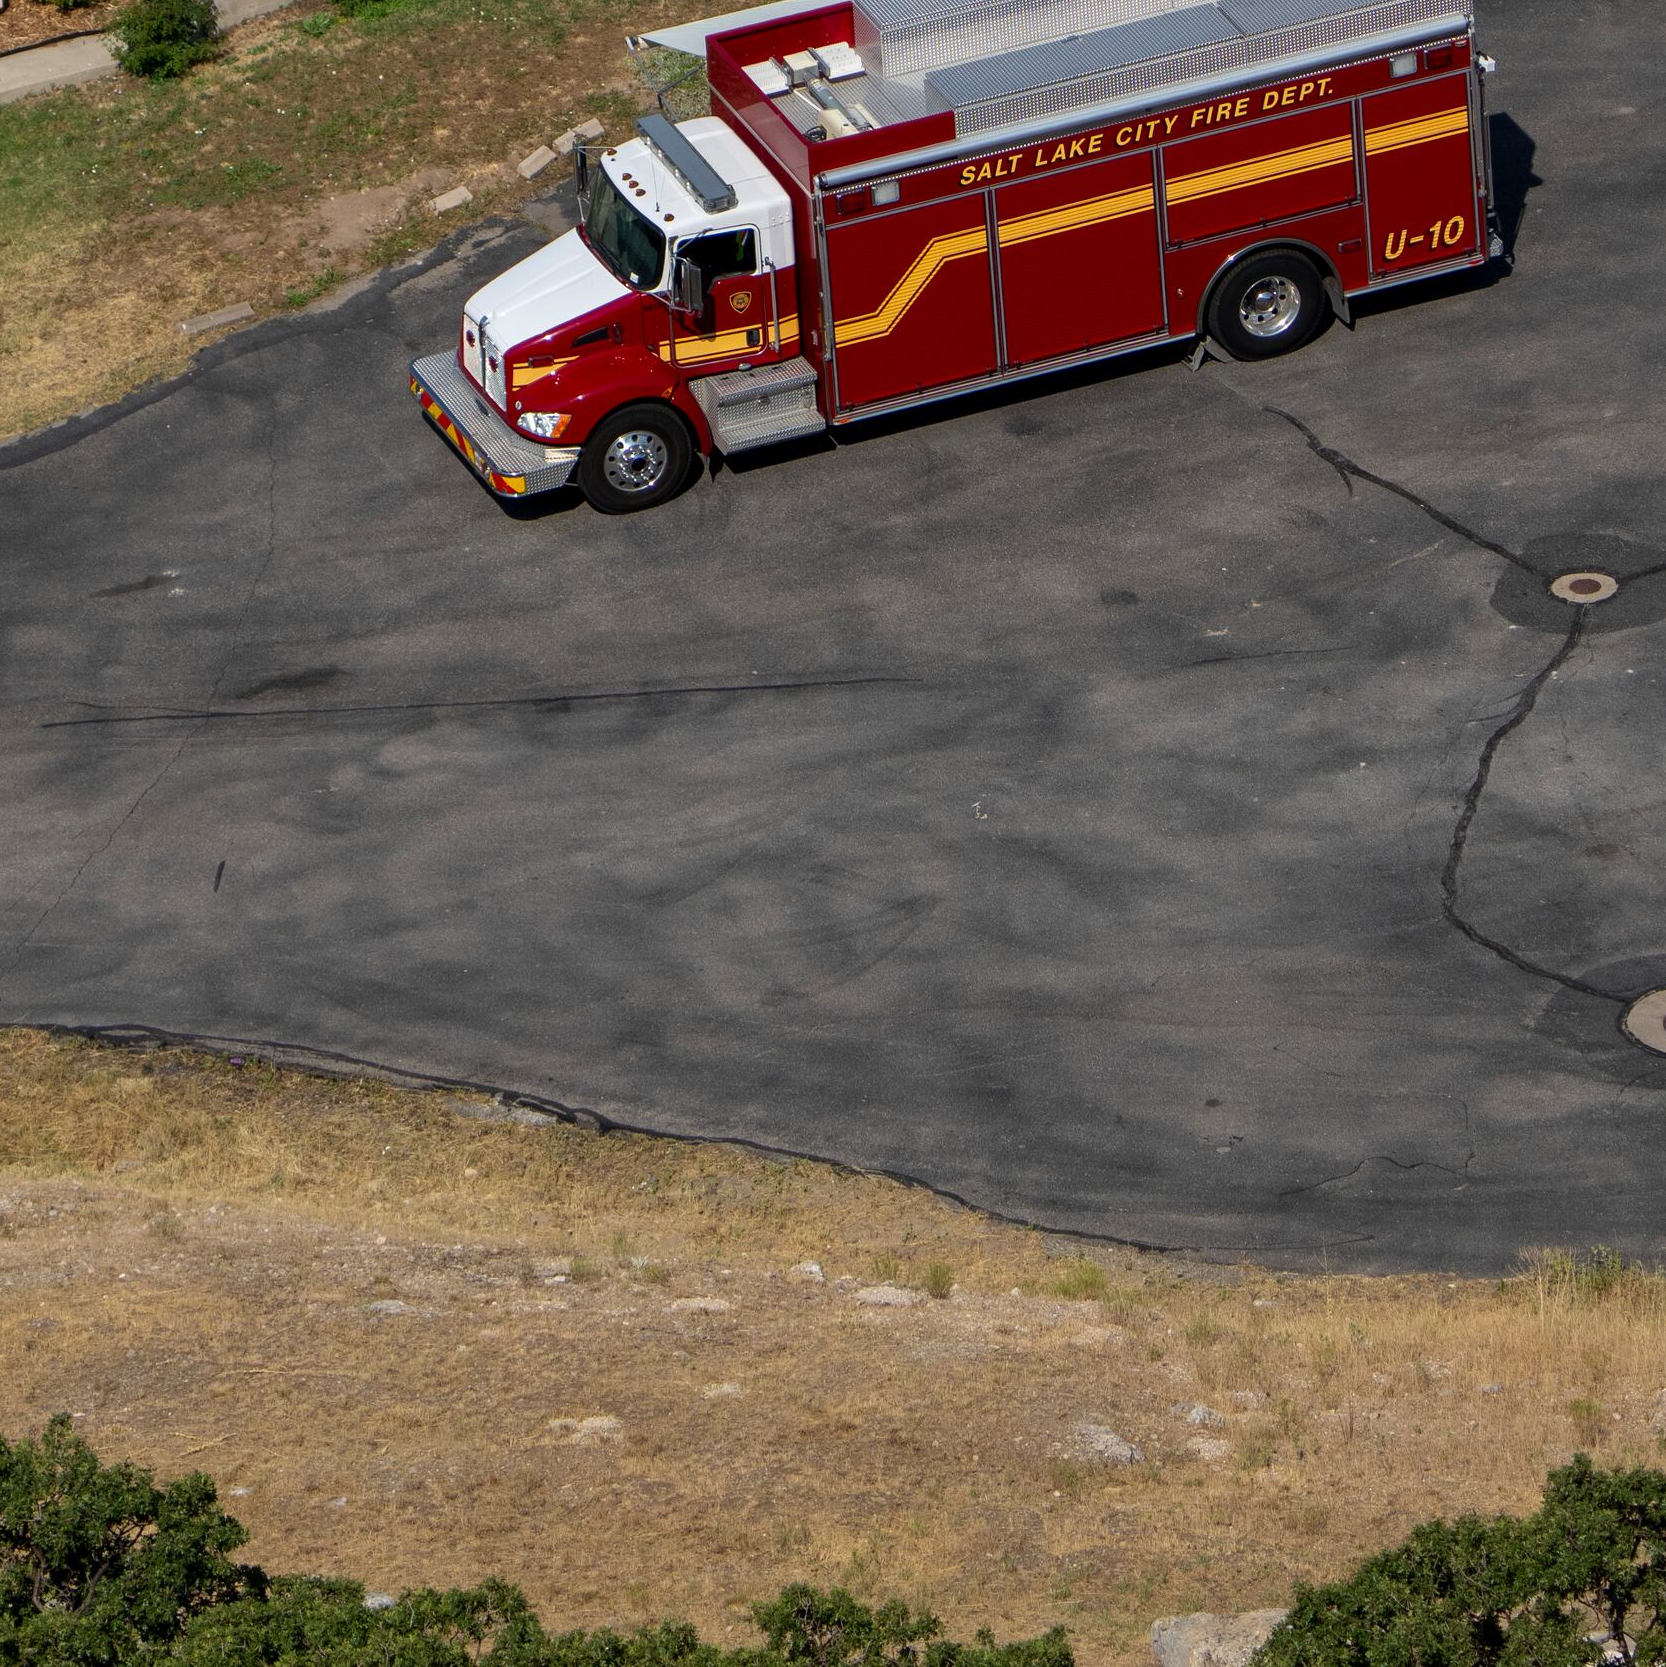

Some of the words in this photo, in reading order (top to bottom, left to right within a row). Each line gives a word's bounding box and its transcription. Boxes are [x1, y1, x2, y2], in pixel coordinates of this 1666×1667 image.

[959, 153, 1023, 186] SALT
[1034, 133, 1104, 168] LAKE
[1115, 114, 1179, 147] CITY
[1190, 97, 1250, 128] FIRE
[1262, 77, 1334, 110] DEPT.
[1385, 215, 1465, 260] U-10
